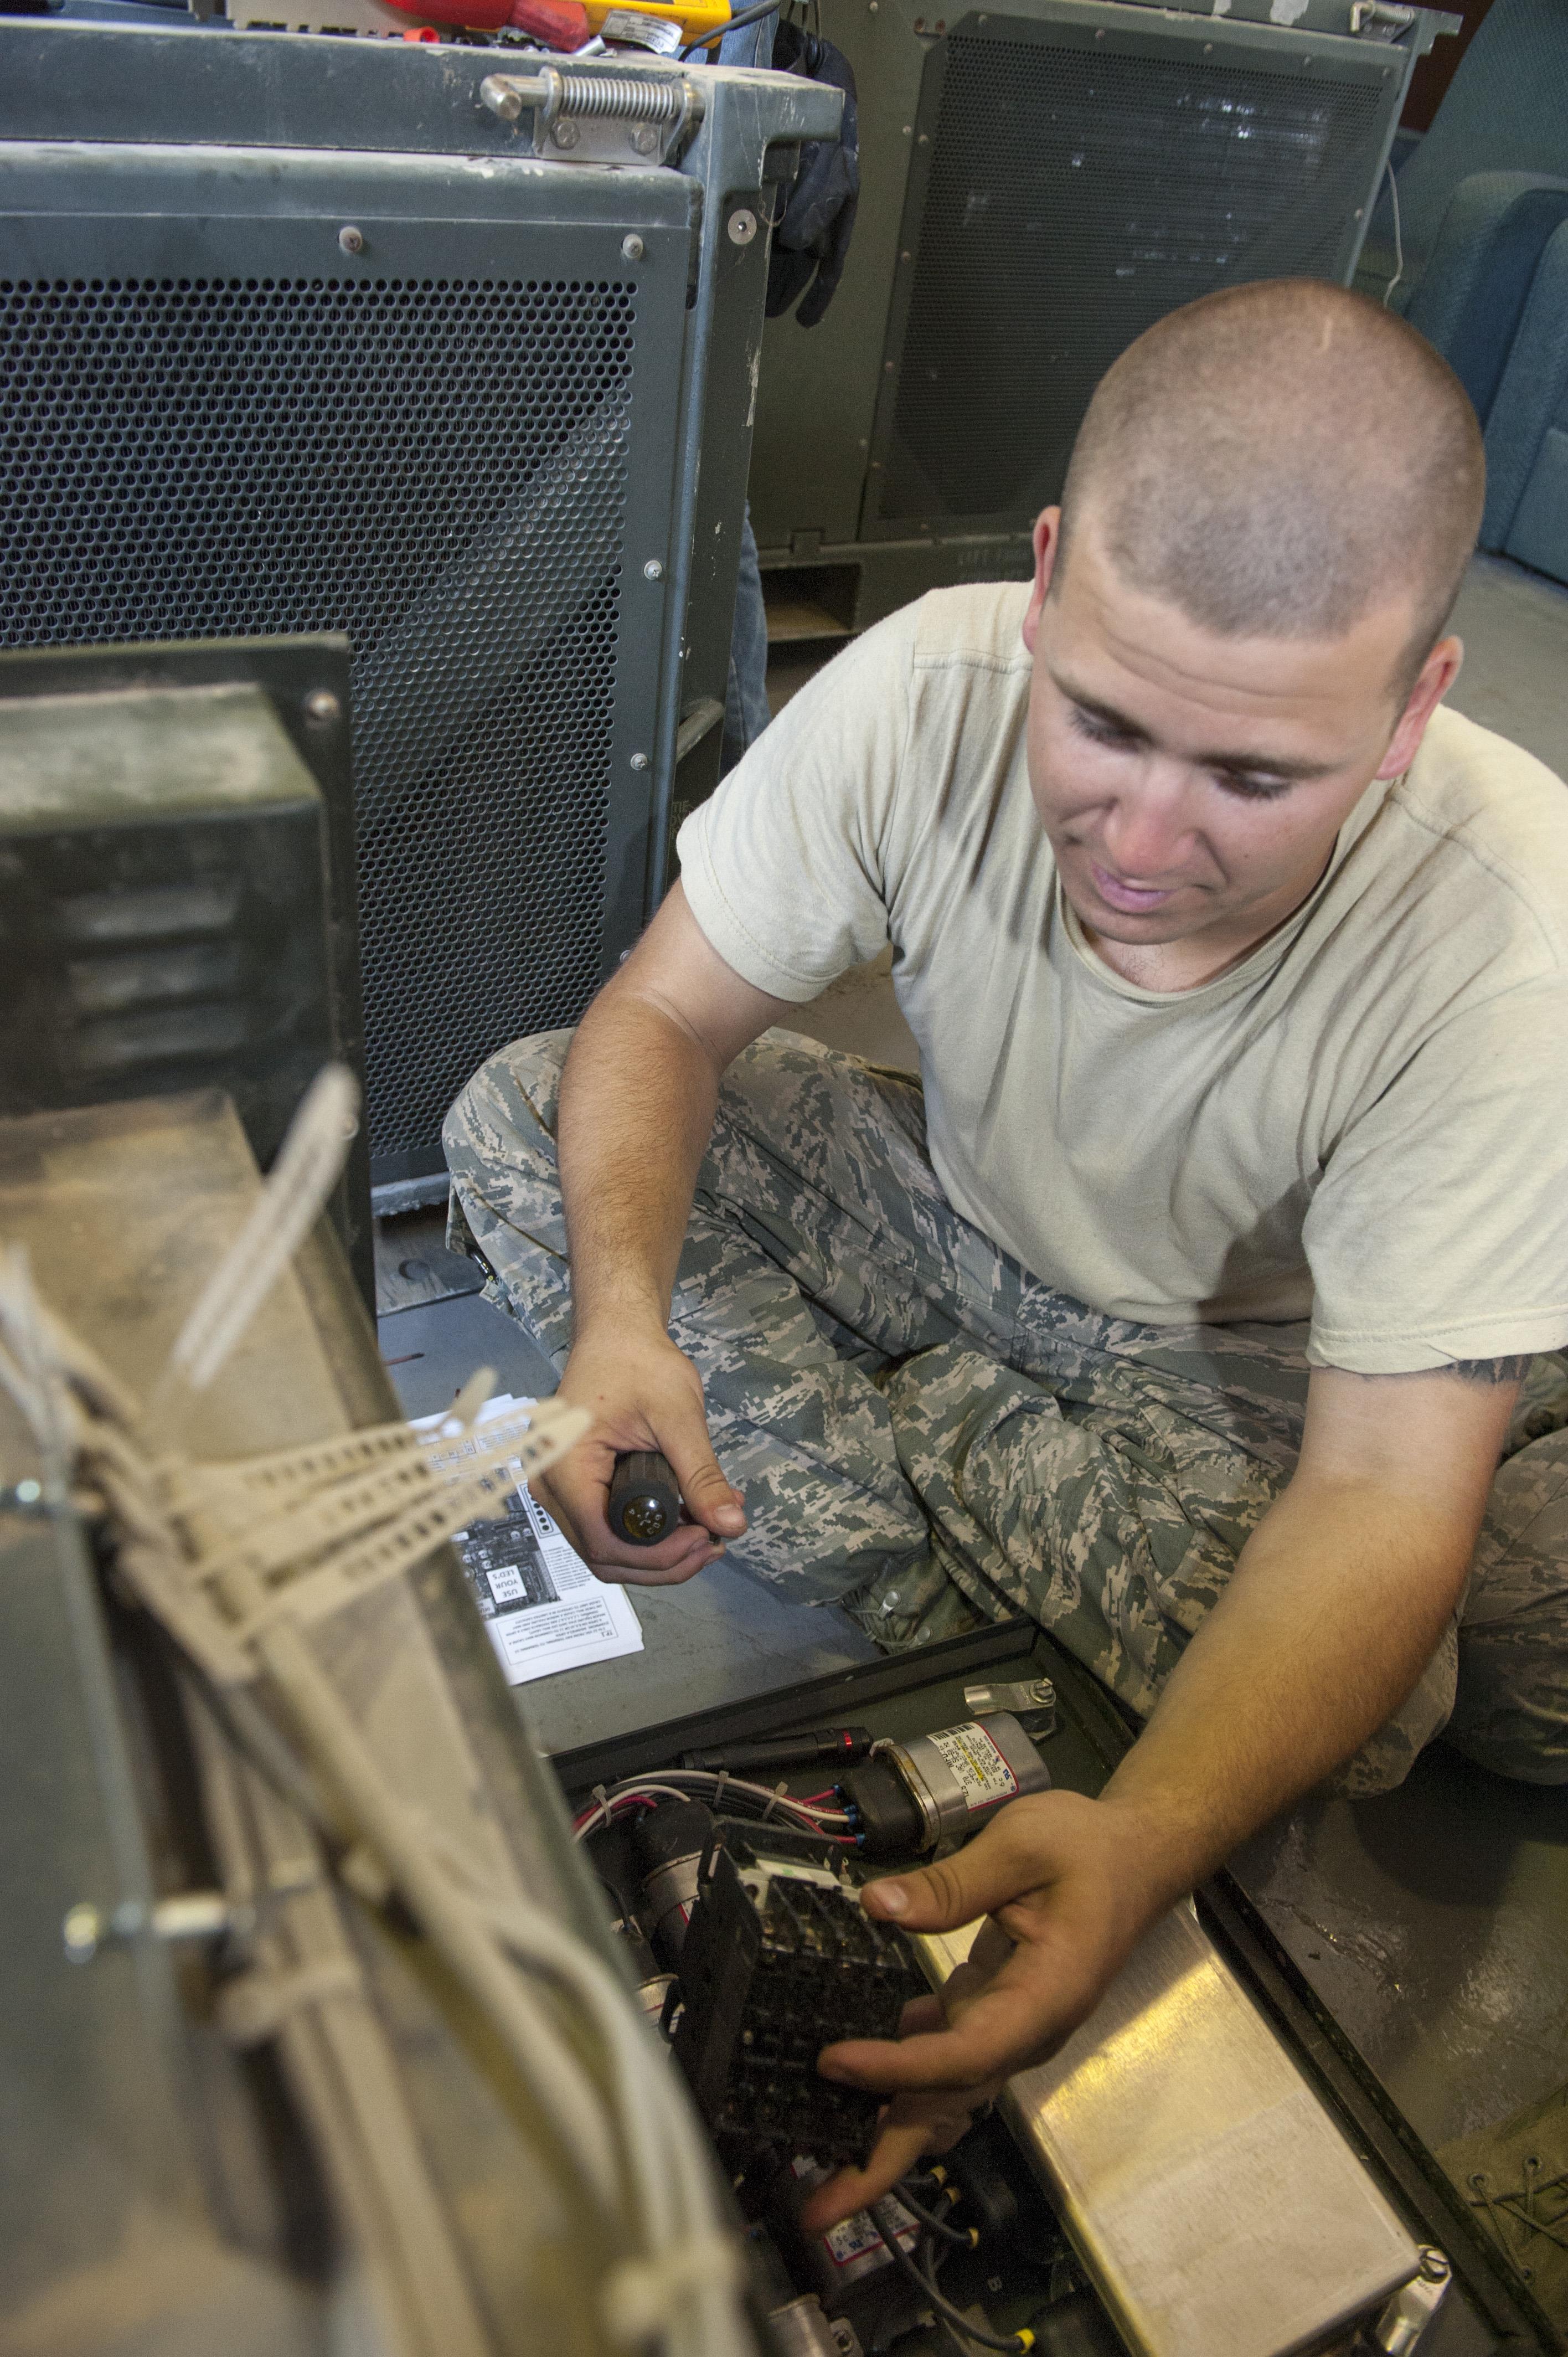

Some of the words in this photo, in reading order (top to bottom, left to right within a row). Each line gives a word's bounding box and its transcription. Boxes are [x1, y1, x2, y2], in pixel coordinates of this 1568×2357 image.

[492, 1569, 514, 1580] LED'S
[494, 1578, 518, 1589] YOUR
[501, 1588, 518, 1598] USE
[962, 1774, 972, 1785] 370
